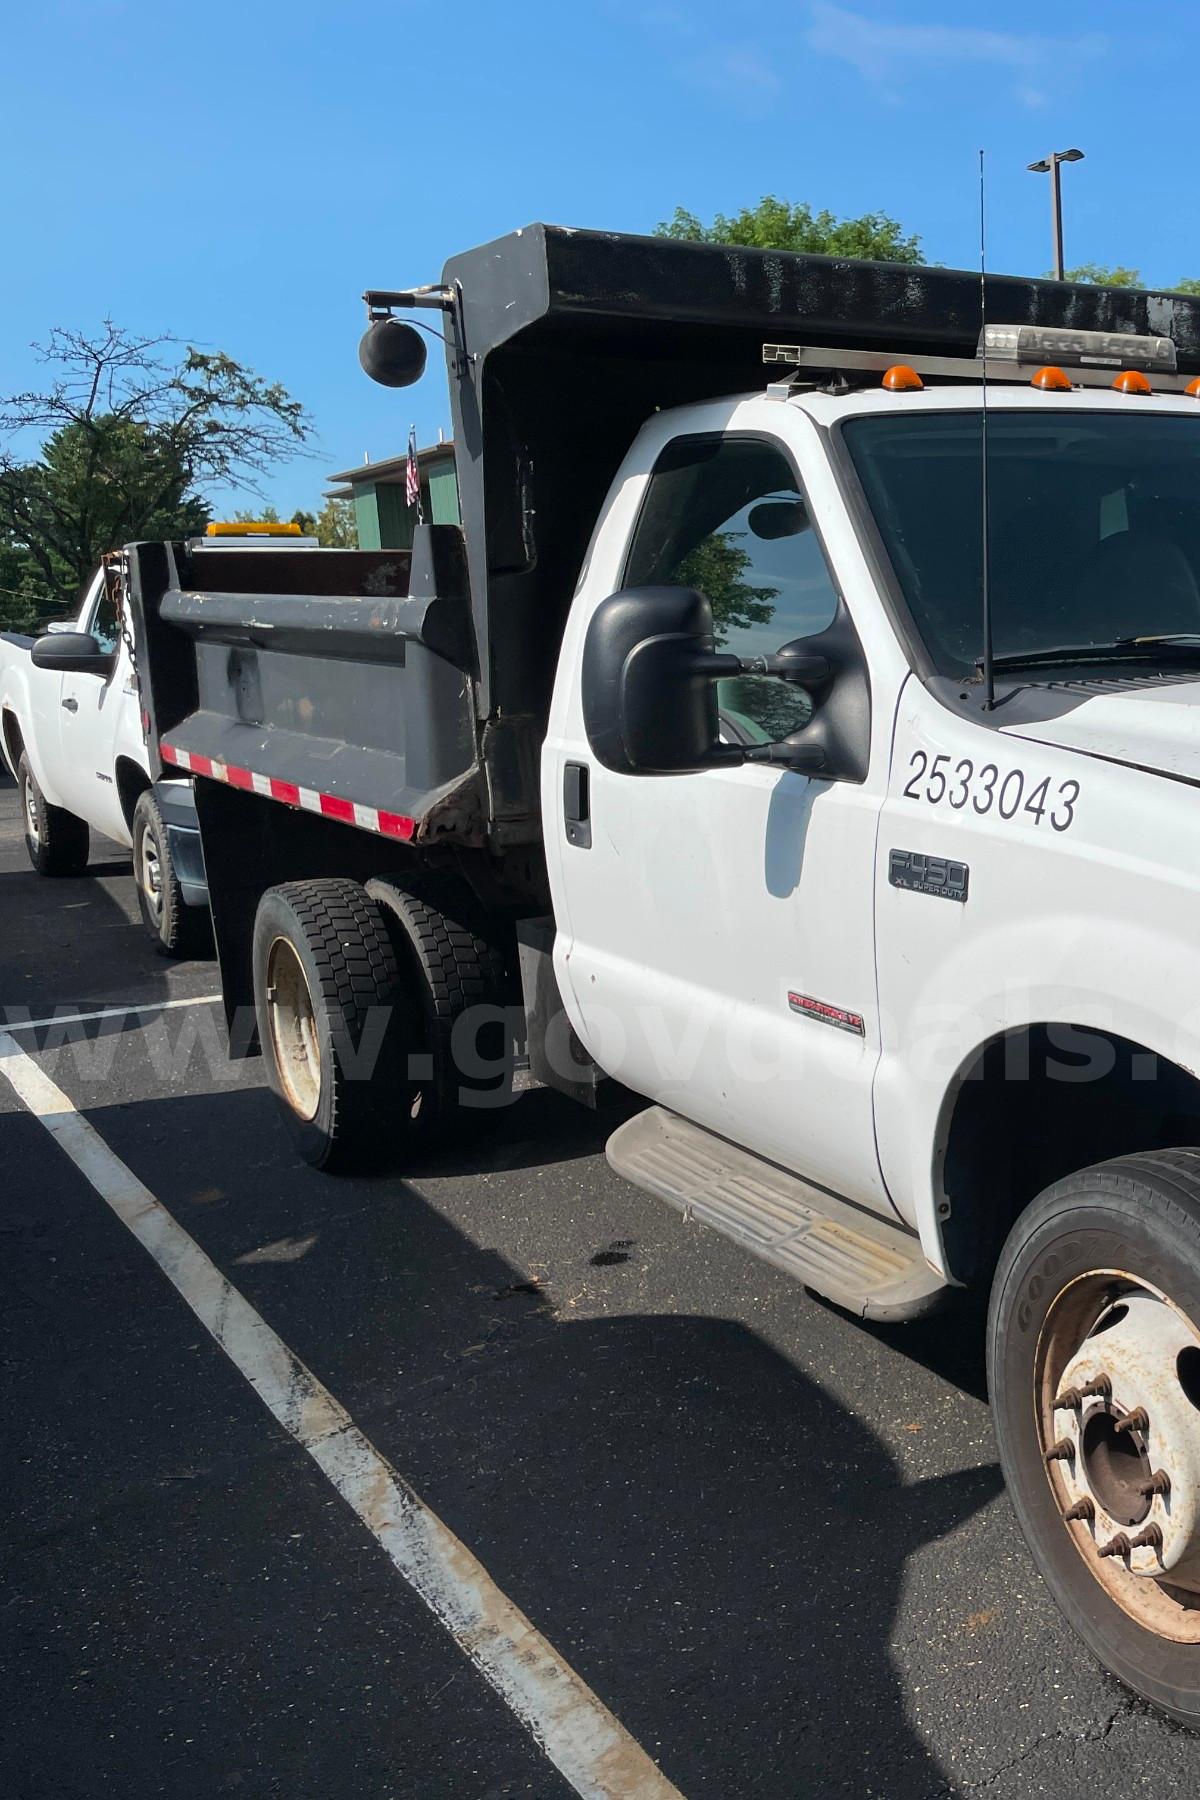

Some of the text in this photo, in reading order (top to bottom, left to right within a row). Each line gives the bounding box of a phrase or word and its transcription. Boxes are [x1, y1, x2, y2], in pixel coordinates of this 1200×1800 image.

[903, 750, 1081, 832] 2533043
[913, 880, 940, 893] SUPER
[941, 886, 965, 899] DUTY
